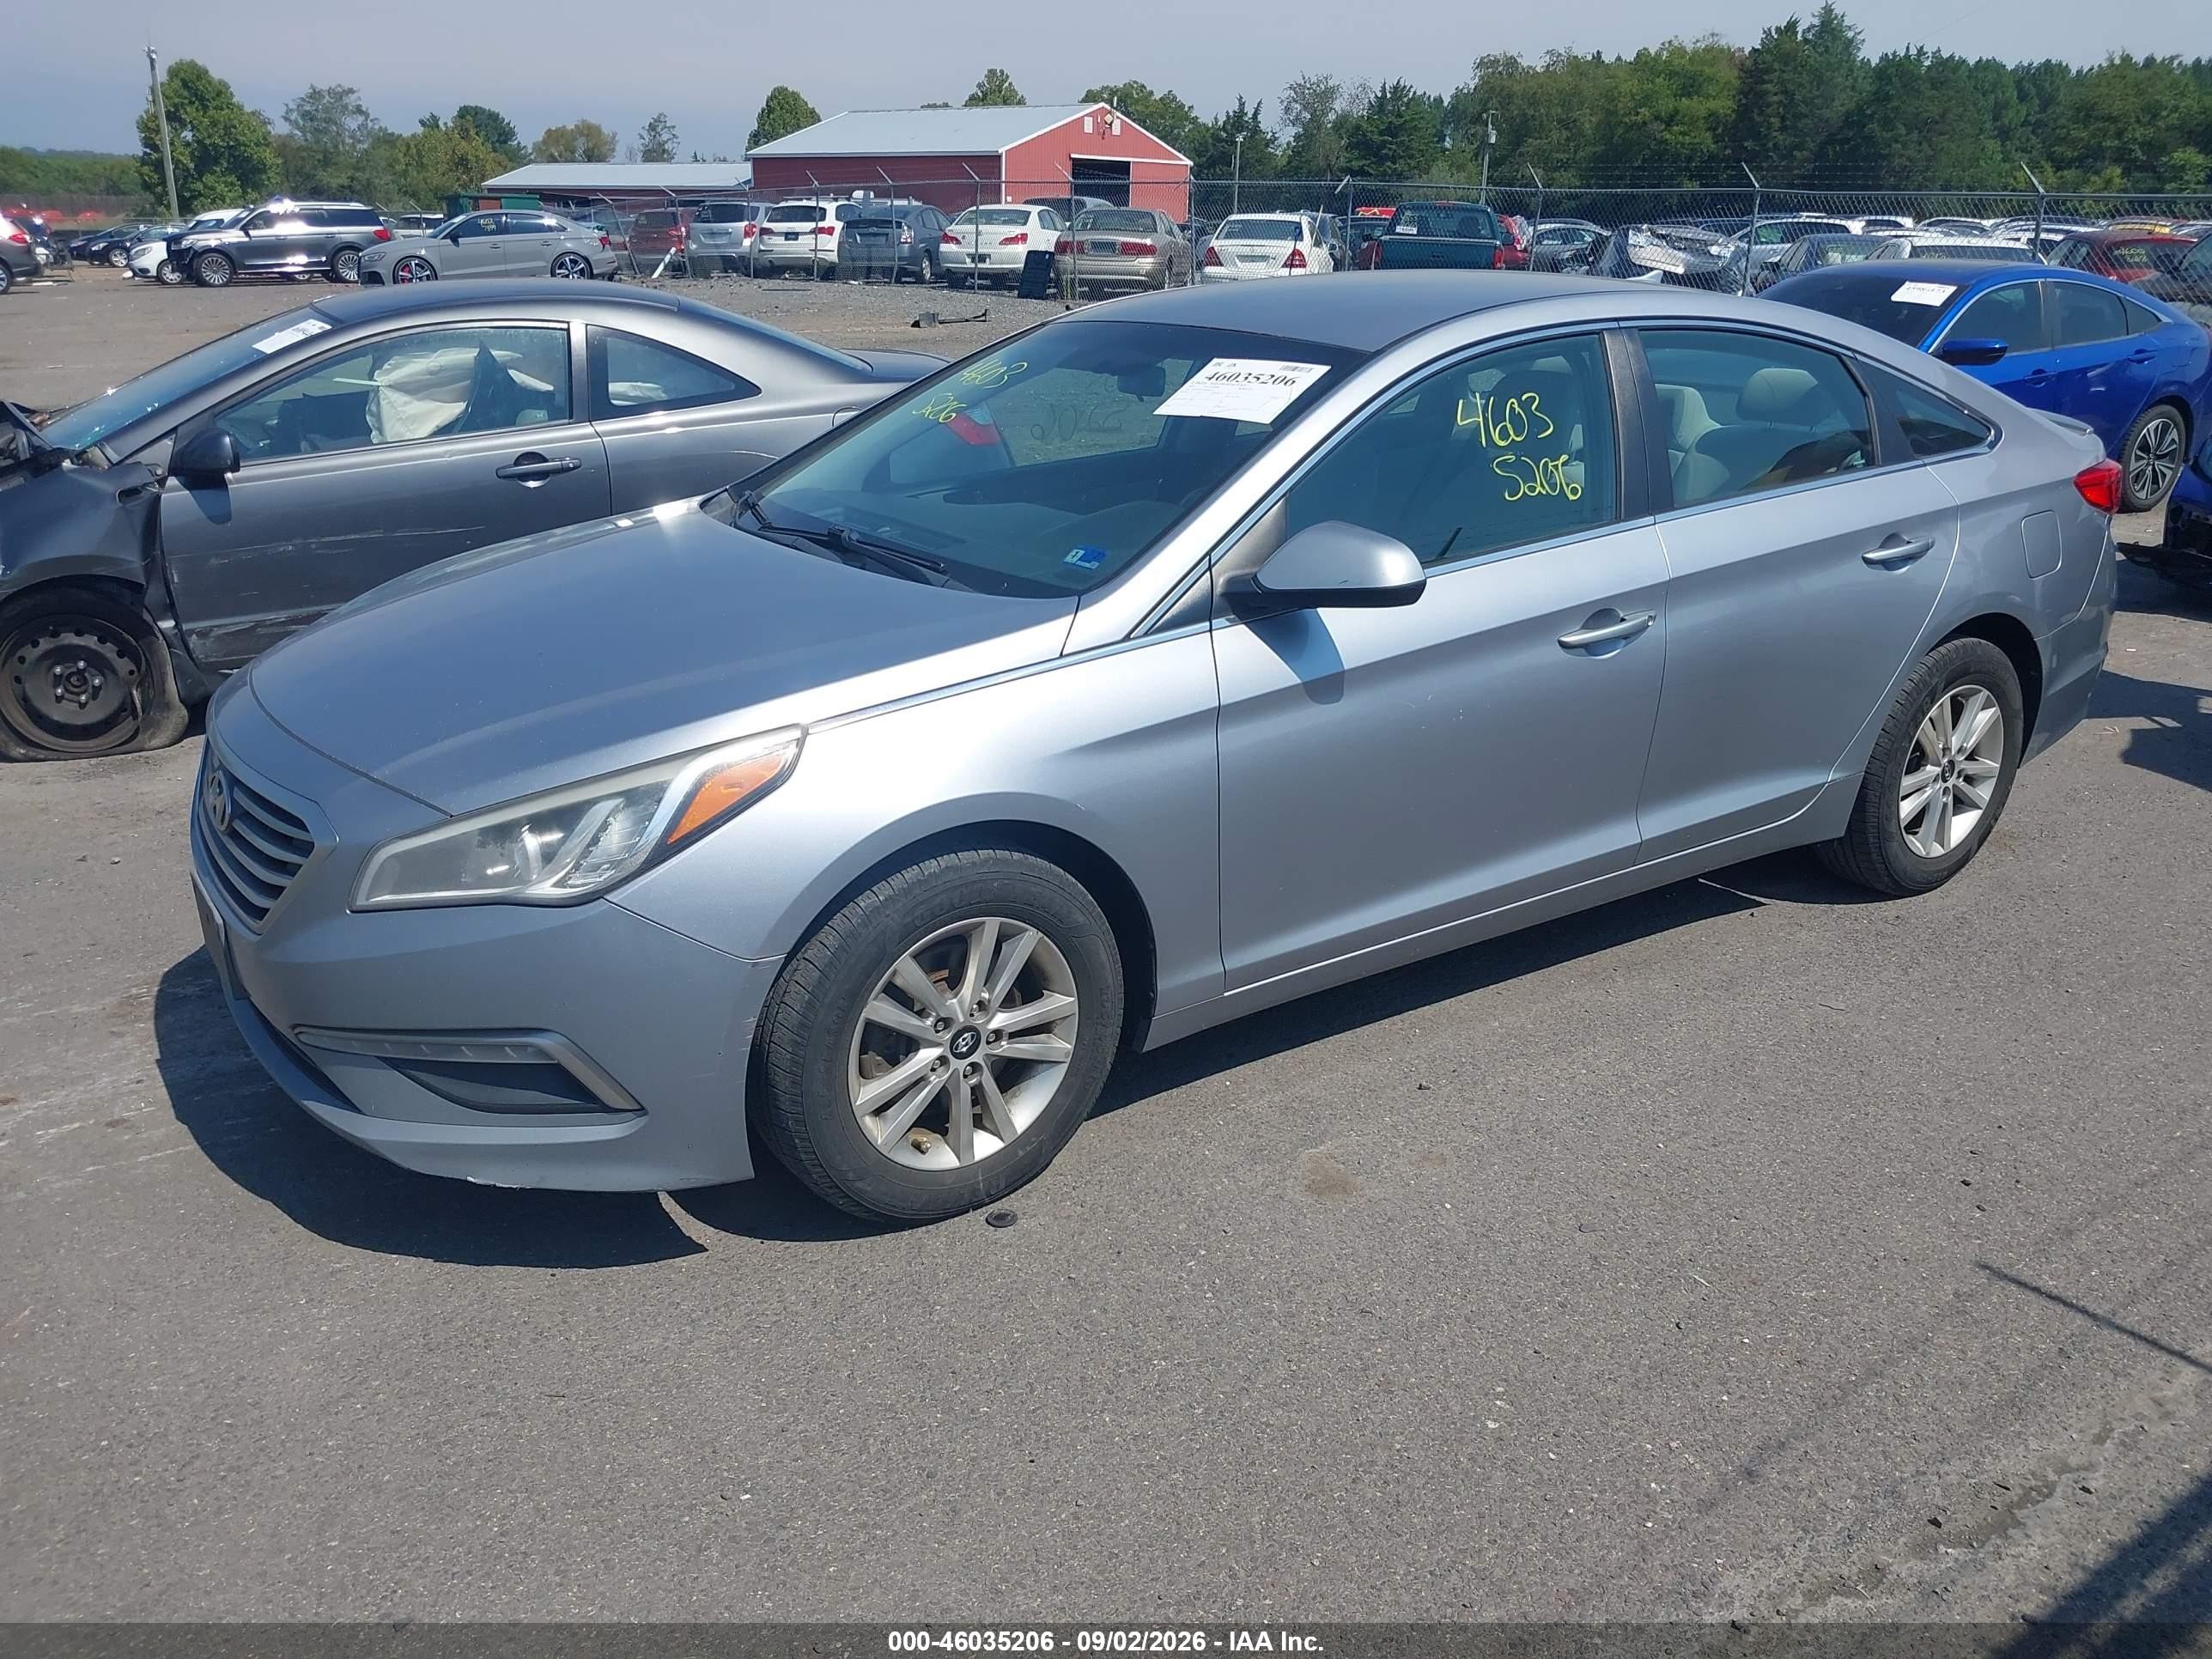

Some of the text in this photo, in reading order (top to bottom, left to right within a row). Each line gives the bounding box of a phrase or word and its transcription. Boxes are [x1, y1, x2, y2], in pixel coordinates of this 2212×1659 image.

[958, 358, 1028, 389] 4603
[1205, 371, 1301, 386] 46035206
[1457, 392, 1554, 448] 4603
[1492, 453, 1582, 501] 5206
